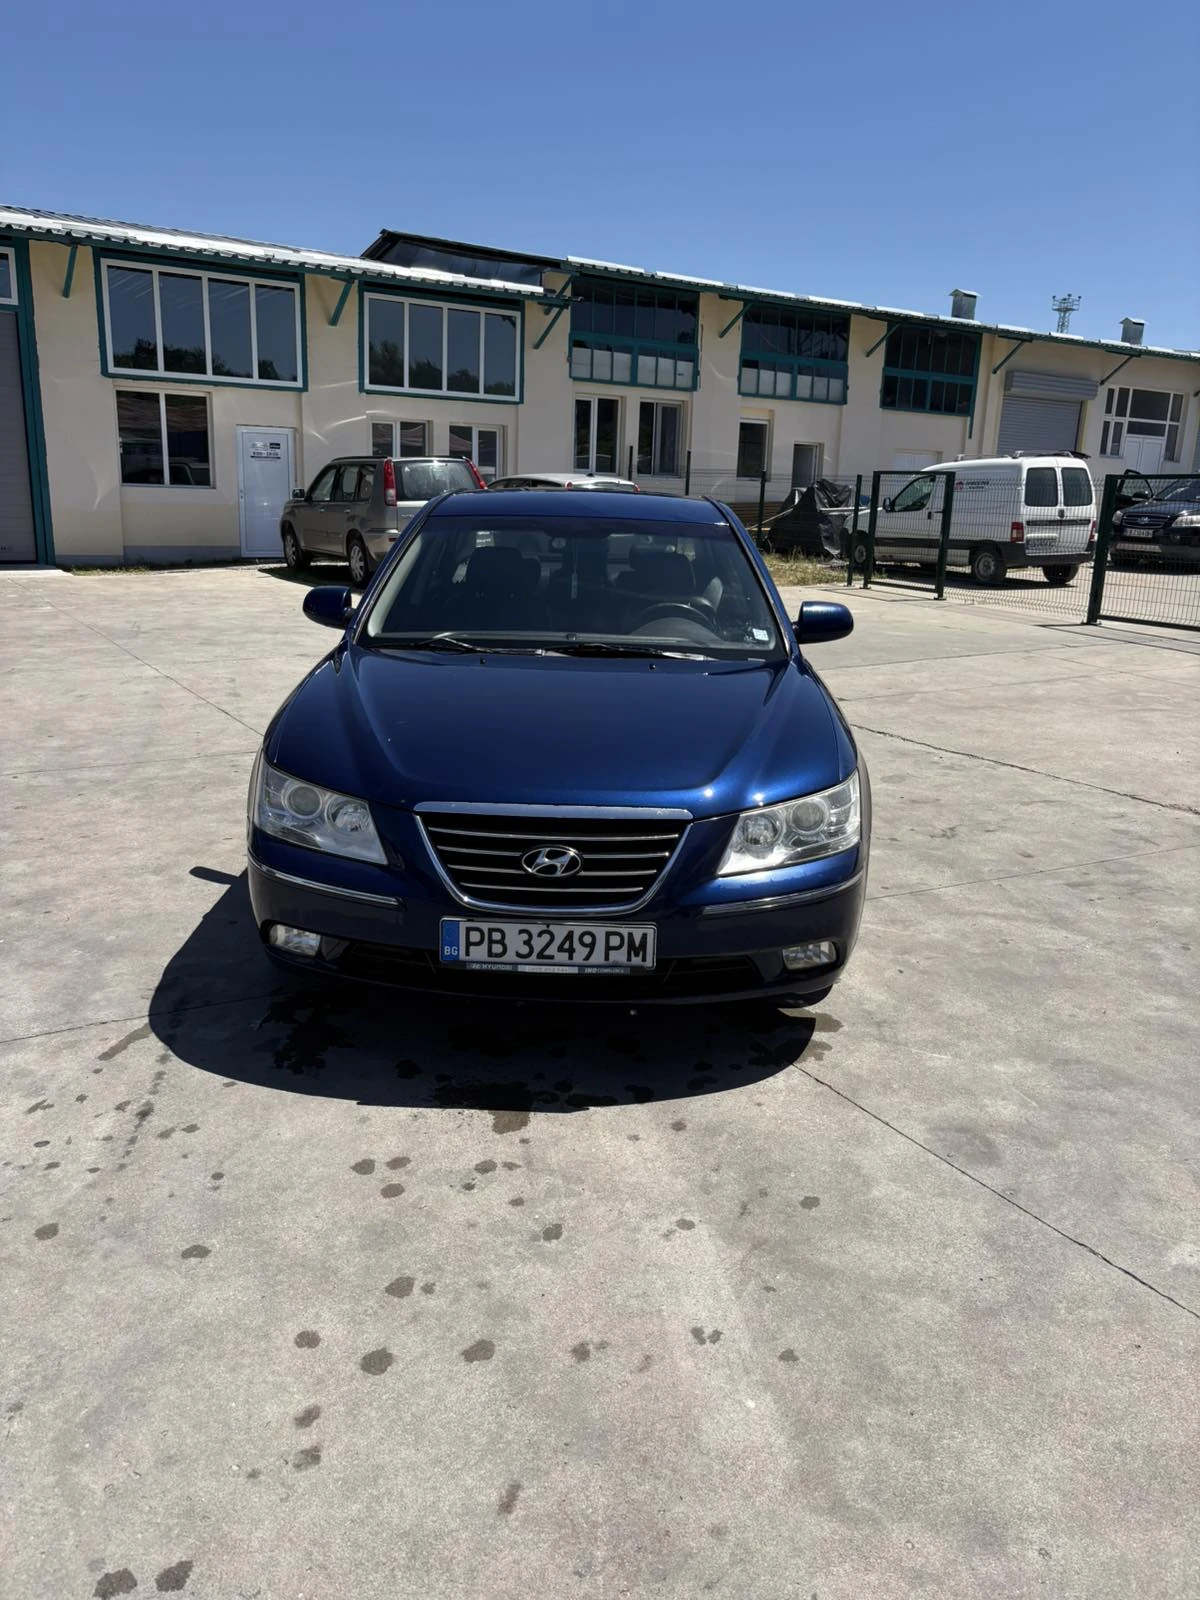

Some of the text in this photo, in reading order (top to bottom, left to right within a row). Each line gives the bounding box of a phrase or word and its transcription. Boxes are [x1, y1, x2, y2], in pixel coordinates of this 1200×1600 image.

[444, 946, 458, 956] BG
[464, 926, 648, 963] PB 3249 PM
